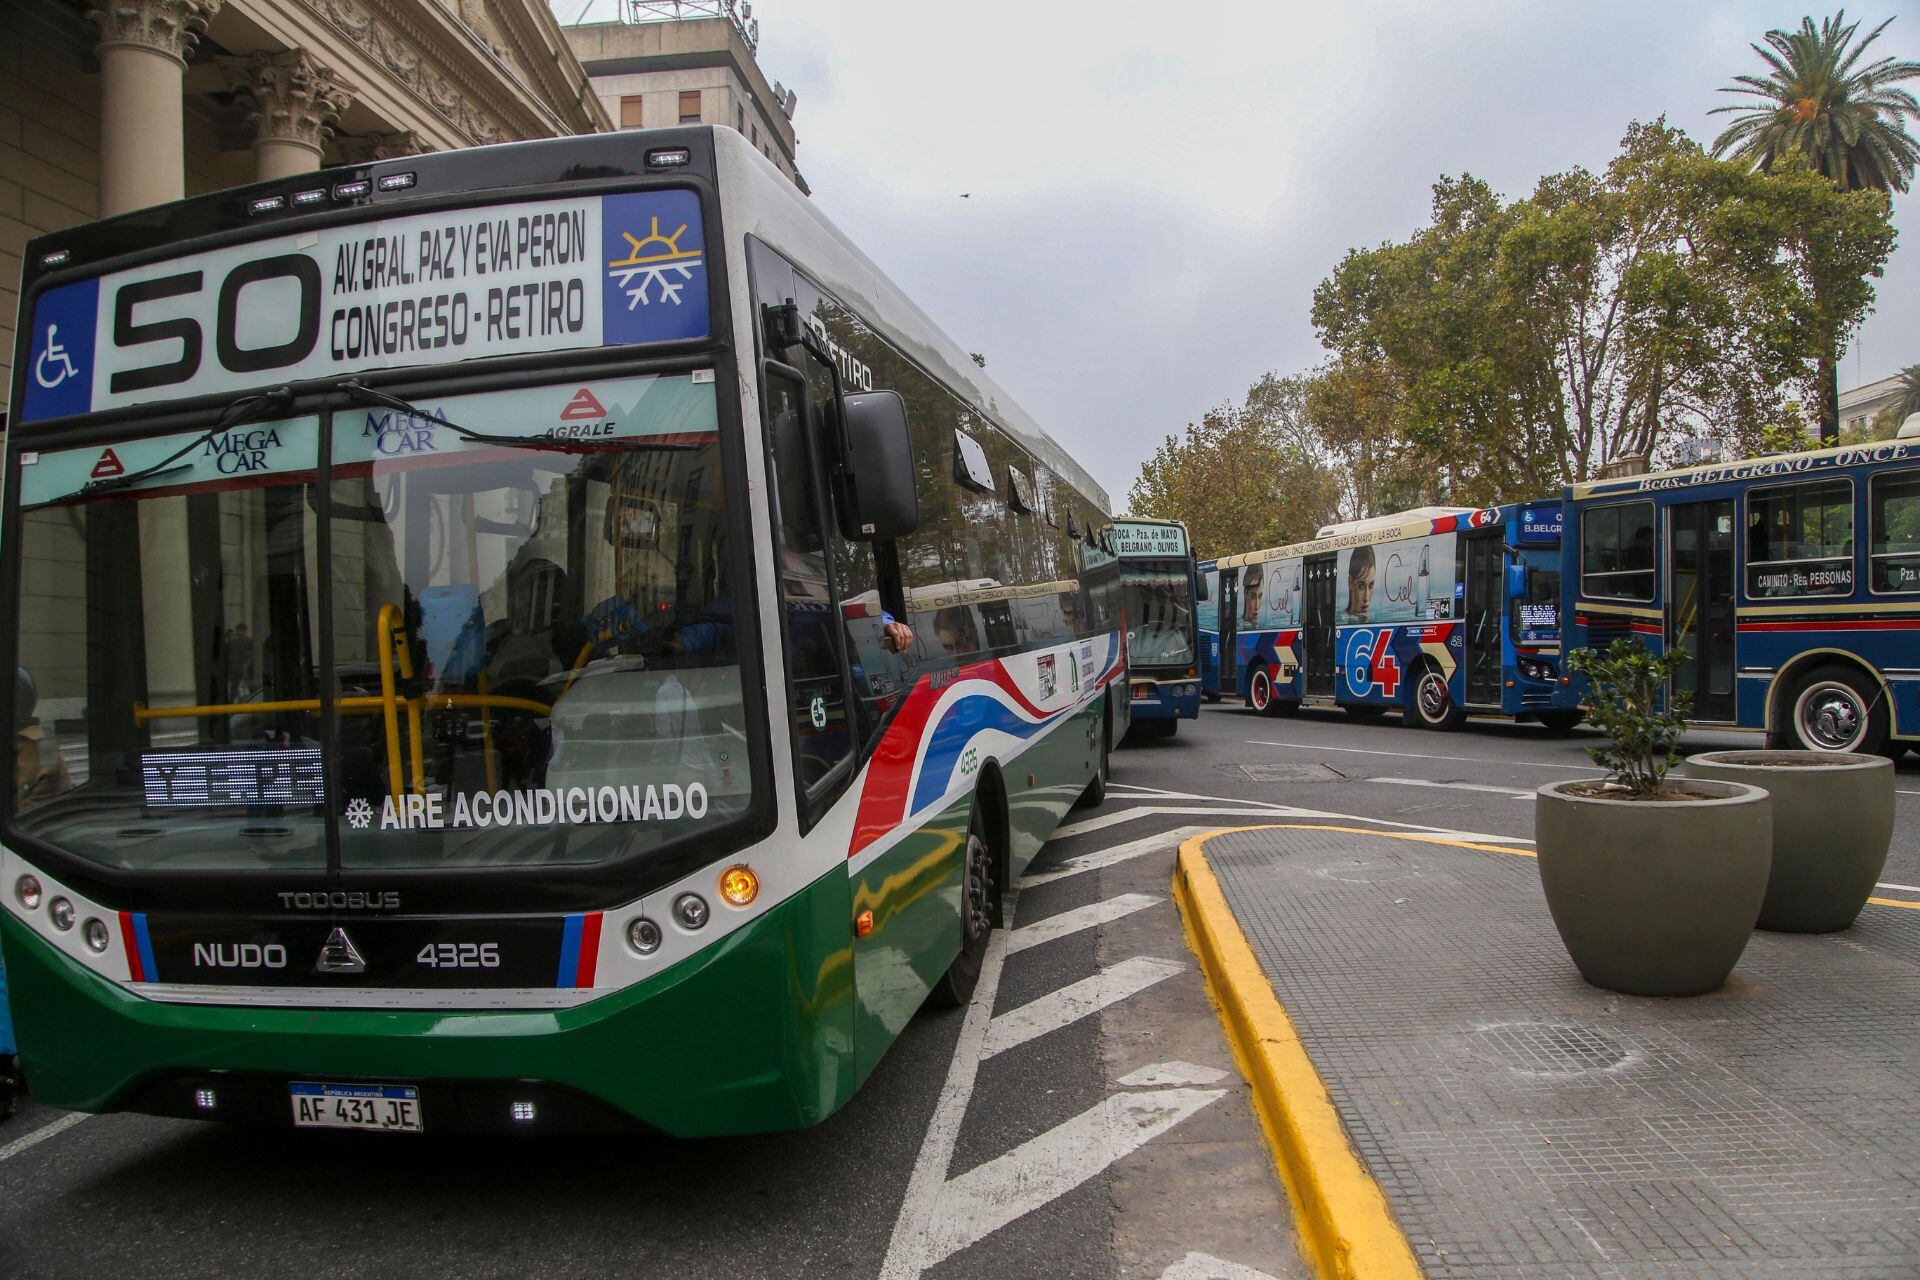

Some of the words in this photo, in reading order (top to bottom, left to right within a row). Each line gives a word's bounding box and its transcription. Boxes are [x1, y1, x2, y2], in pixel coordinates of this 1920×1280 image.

[333, 241, 358, 295] AV.
[362, 234, 414, 290] GRAL.
[418, 226, 456, 283] PAZ
[460, 224, 473, 277] Y
[475, 219, 513, 275] EVA
[517, 209, 585, 269] PERON
[110, 253, 322, 395] 50
[331, 292, 468, 361] CONGRESO
[487, 278, 584, 342] RETIRO
[361, 406, 449, 437] MEGA
[544, 422, 616, 440] AGRALE
[203, 428, 285, 457] MEGA
[376, 430, 440, 455] CAR
[216, 450, 269, 475] CAR
[1637, 476, 1684, 492] Bcas.
[1688, 456, 1814, 485] BELGRANO
[1834, 443, 1911, 467] ONCE
[1479, 511, 1492, 524] 64
[1136, 528, 1150, 540] Pza.
[1151, 528, 1159, 540] de
[1160, 528, 1178, 540] MAYO
[1358, 532, 1373, 544] MAYO
[1386, 527, 1402, 539] BOCA
[1121, 541, 1153, 553] BELGRANO
[1157, 542, 1179, 553] OLIVOS
[1385, 553, 1416, 606] Ciel
[1758, 574, 1788, 588] CAMINITO
[1809, 570, 1851, 586] PERSONAS
[1900, 567, 1917, 581] Pza.
[1440, 603, 1450, 614] 64
[1450, 635, 1463, 647] 42
[1344, 628, 1401, 698] 64
[961, 747, 978, 776] 4326
[380, 793, 445, 830] AIRE
[453, 781, 709, 829] ACONDICIONADO
[277, 891, 401, 910] TODOBUS
[193, 943, 287, 968] NUDO
[416, 943, 500, 968] 4326
[324, 1088, 352, 1097] REPÚBLICA
[353, 1090, 384, 1098] ARGENTINA
[300, 1097, 326, 1122] AF
[336, 1098, 378, 1125] 431
[386, 1101, 416, 1127] JE
